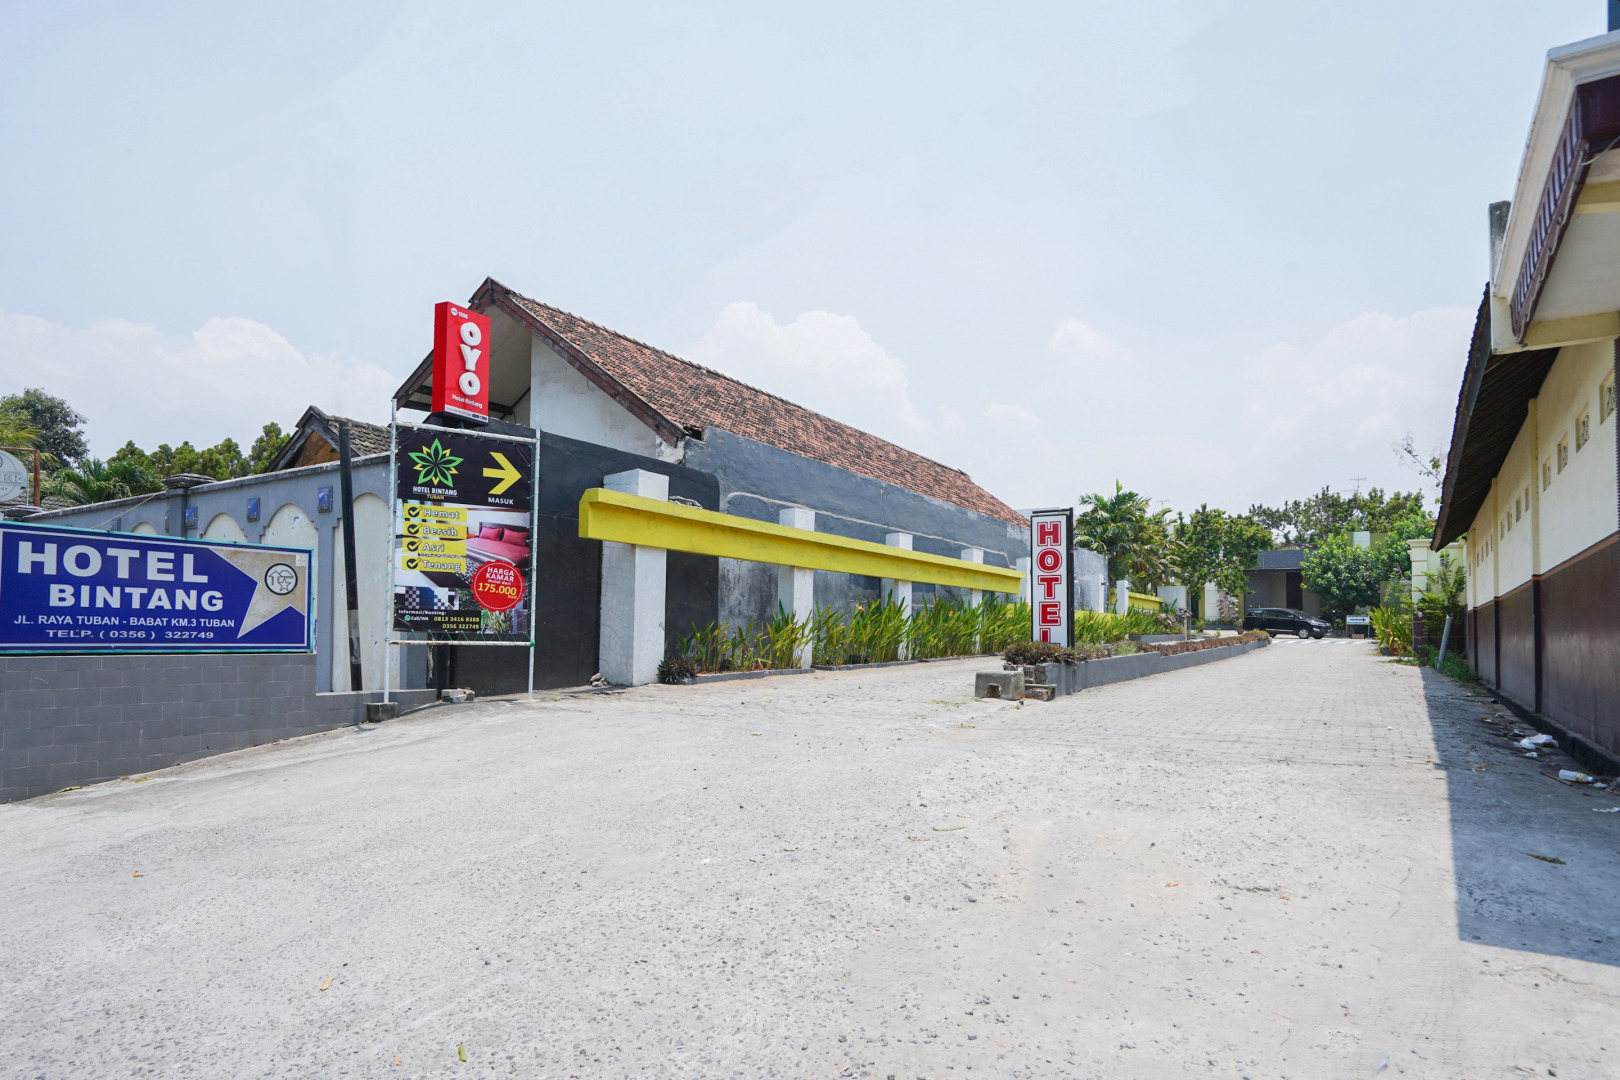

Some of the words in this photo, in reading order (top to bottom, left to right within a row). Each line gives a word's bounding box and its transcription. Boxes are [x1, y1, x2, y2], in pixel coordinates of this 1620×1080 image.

[459, 322, 482, 396] OYO
[451, 394, 465, 403] Hotel
[465, 397, 483, 409] Bintang
[431, 487, 458, 496] BINTANG
[488, 497, 514, 505] MASUK
[423, 508, 460, 519] Hemat
[423, 526, 458, 536] Bersih
[422, 543, 445, 552] Asri
[18, 541, 209, 584] HOTEL
[422, 560, 461, 571] Tenang
[486, 572, 514, 582] KAMAR
[487, 567, 515, 576] HARGA
[478, 582, 517, 596] 175.000
[1036, 521, 1062, 647] HOTEL
[49, 584, 224, 612] BINTANG
[14, 615, 34, 625] JL.
[38, 615, 73, 625] RAYA
[77, 616, 119, 626] TUBAN
[130, 617, 168, 627] BABAT
[171, 617, 197, 627] KM.3
[200, 619, 235, 628] TUBAN
[46, 629, 94, 638] TELP.
[109, 630, 147, 638] 0356
[165, 631, 214, 639] 322749
